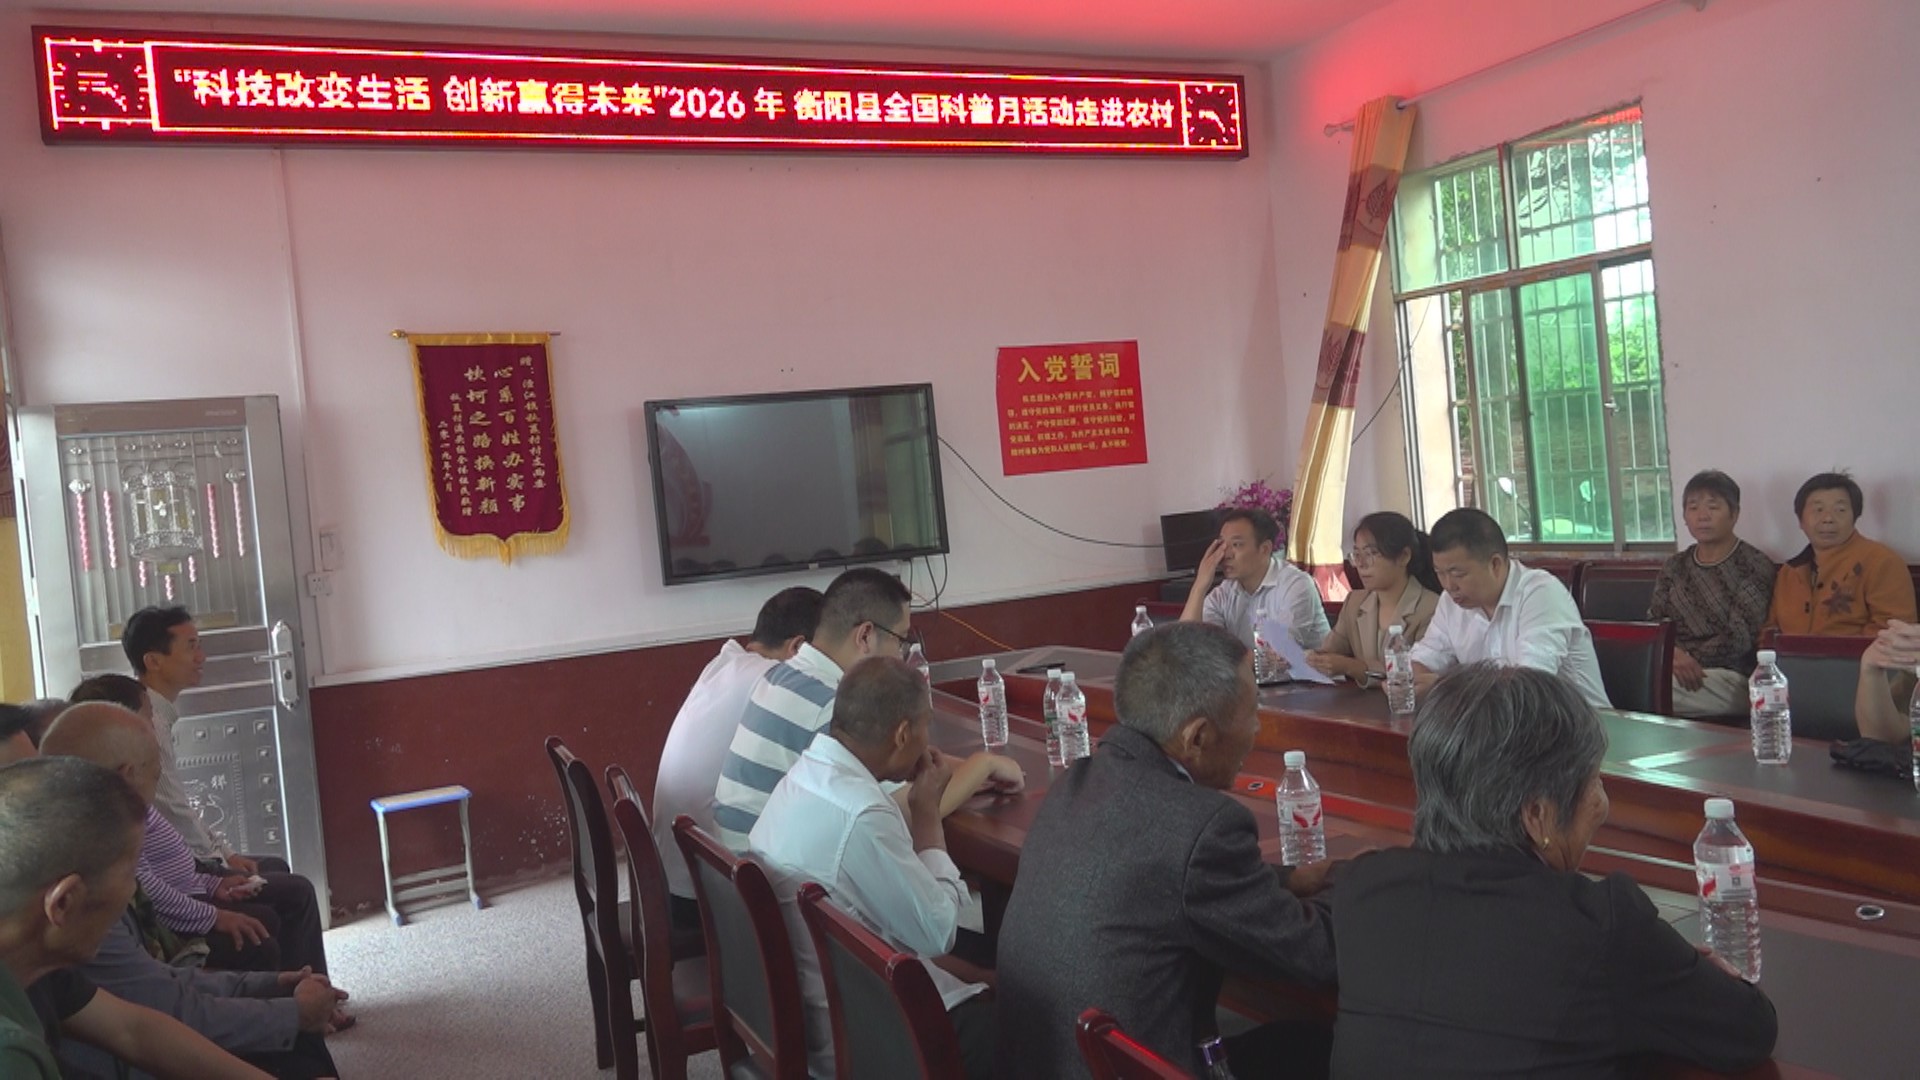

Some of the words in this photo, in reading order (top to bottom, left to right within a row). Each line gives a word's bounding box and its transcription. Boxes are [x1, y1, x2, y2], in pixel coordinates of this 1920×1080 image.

[753, 87, 786, 119] 年
[793, 89, 1173, 127] 衡阳县全国科普月活动走进农村
[1018, 353, 1121, 383] 入党誓词
[494, 366, 526, 513] 心系百姓办实事
